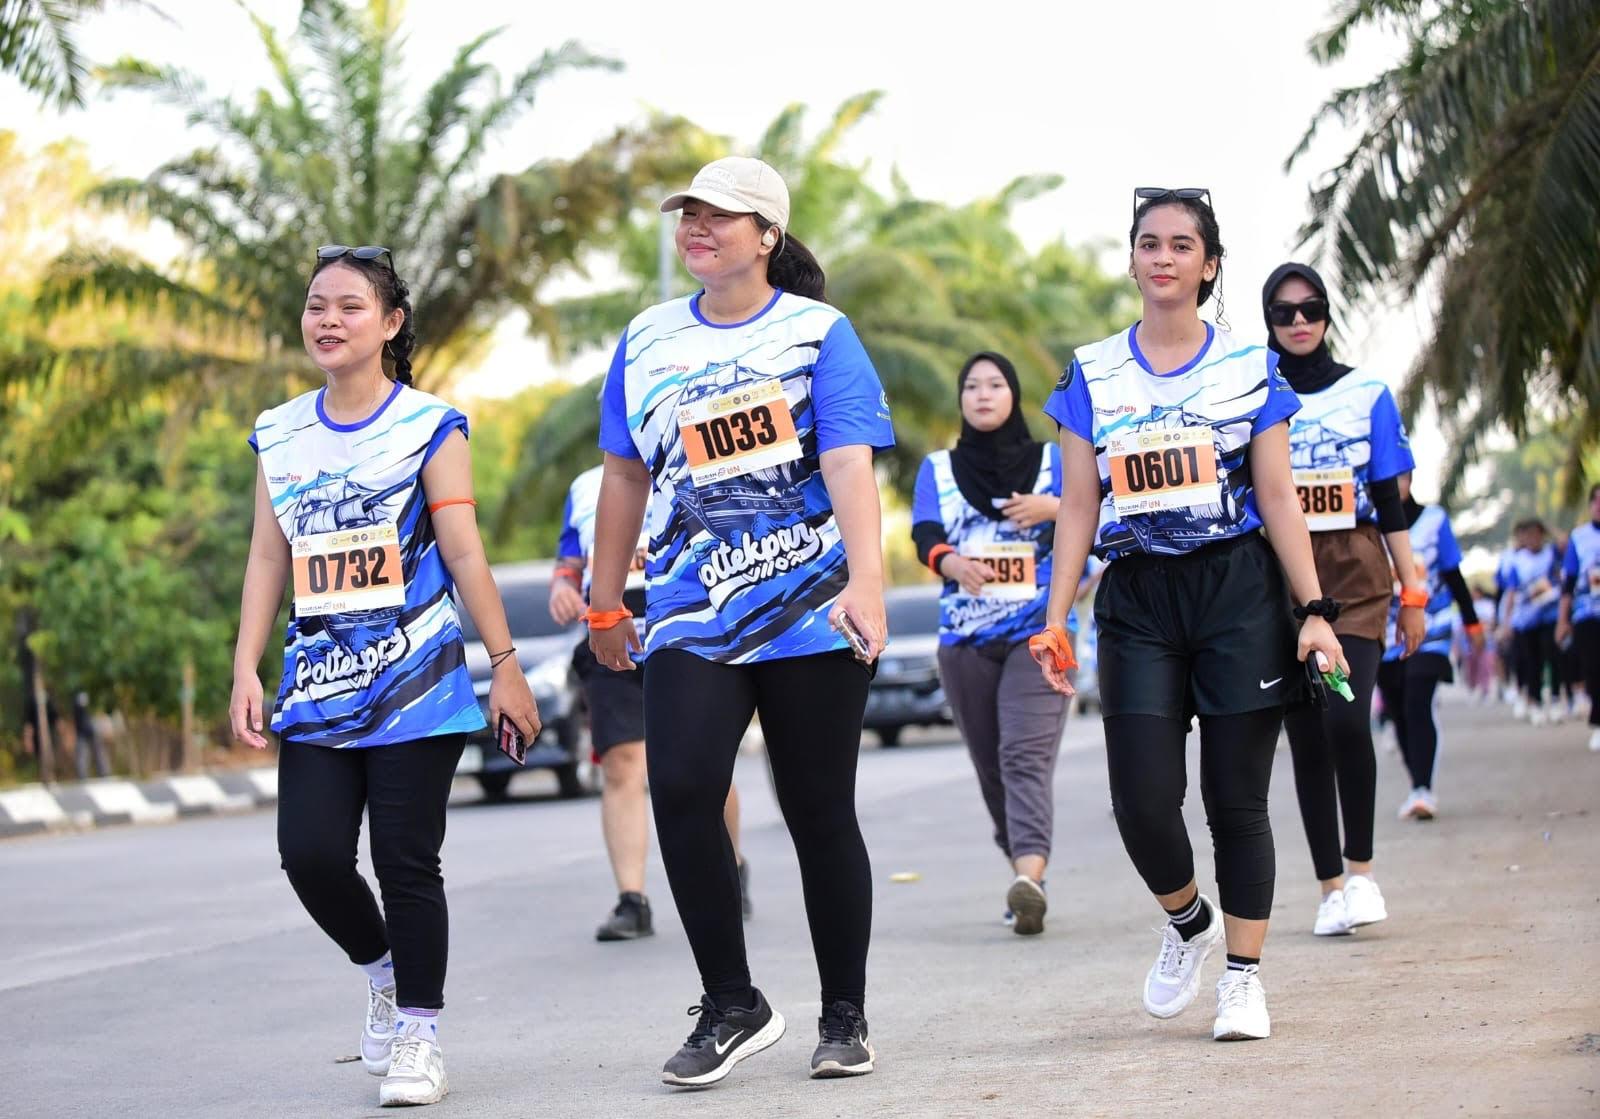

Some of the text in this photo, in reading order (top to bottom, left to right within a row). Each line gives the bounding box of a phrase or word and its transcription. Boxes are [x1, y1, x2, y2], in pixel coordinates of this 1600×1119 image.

[695, 405, 777, 460] 1033
[1125, 447, 1199, 492] 0601
[308, 546, 389, 593] 0732
[968, 557, 1025, 584] 93
